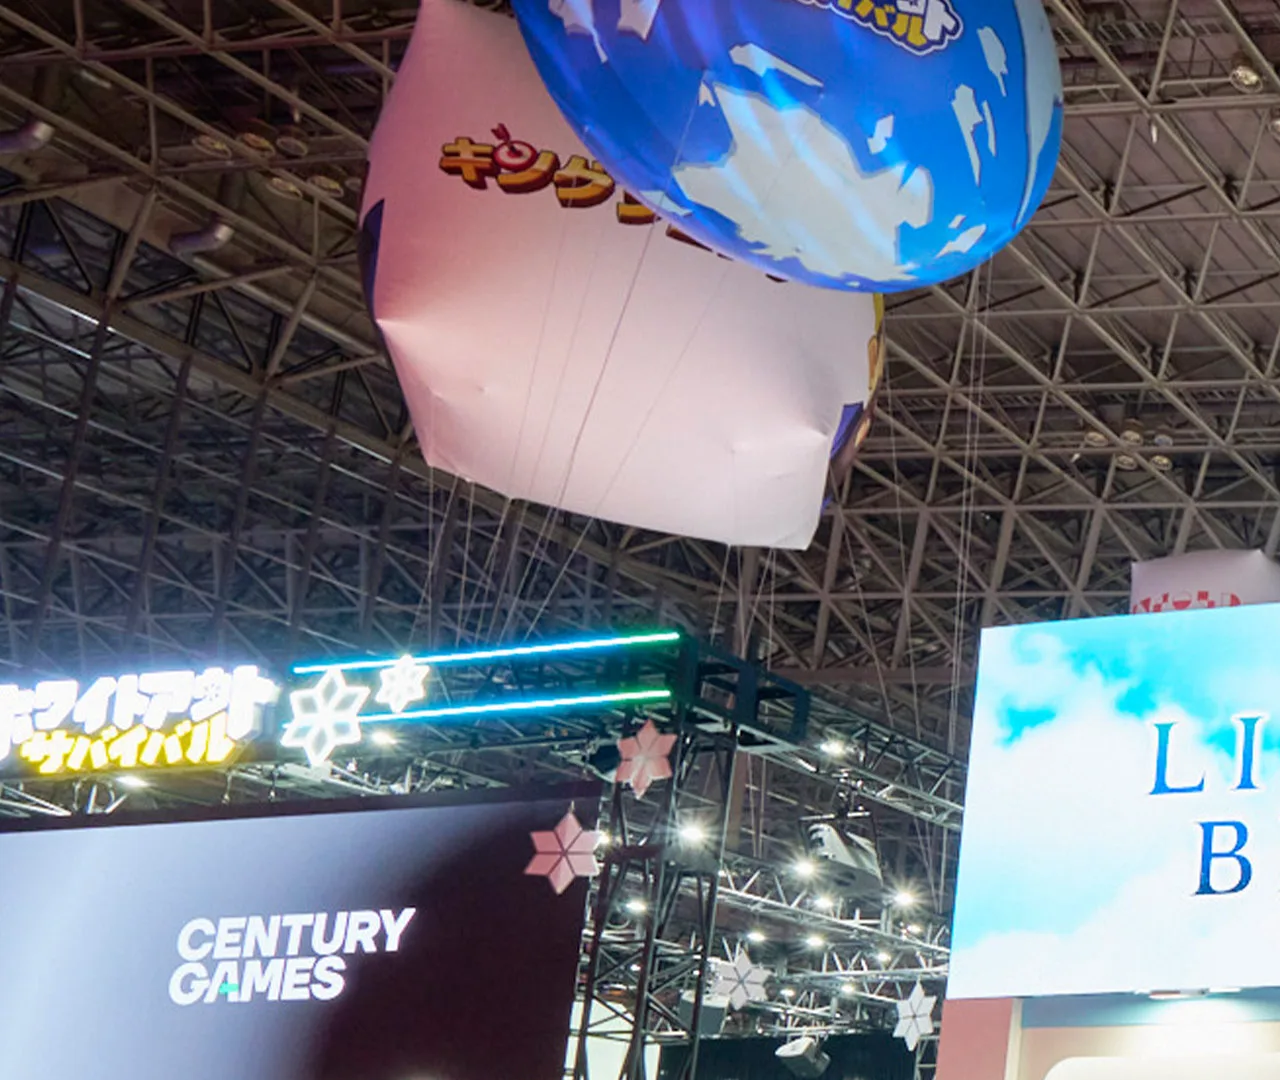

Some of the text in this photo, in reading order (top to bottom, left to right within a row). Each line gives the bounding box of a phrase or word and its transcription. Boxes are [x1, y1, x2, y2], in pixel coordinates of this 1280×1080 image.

[19, 710, 238, 775] サバイバル
[176, 907, 417, 963] CENTURY
[168, 955, 348, 1006] GAMES
